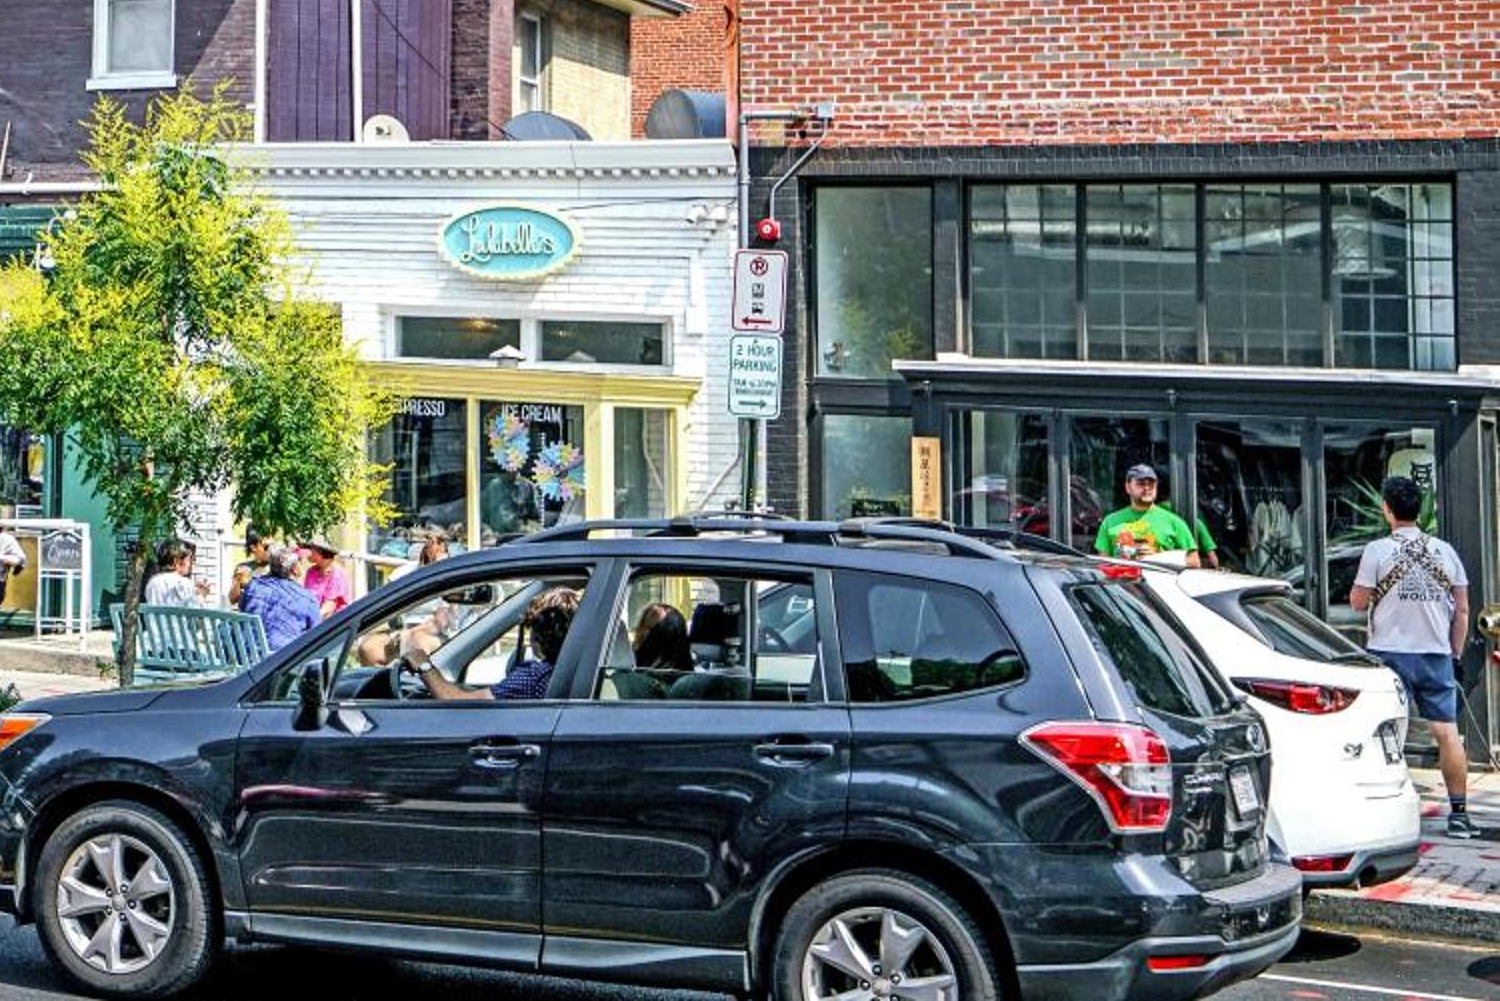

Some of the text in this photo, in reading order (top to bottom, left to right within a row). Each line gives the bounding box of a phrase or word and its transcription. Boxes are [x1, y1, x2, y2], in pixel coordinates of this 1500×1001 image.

[737, 345, 775, 357] 2 HOUR
[734, 359, 777, 373] PARKING
[503, 404, 562, 422] ICE CREAM
